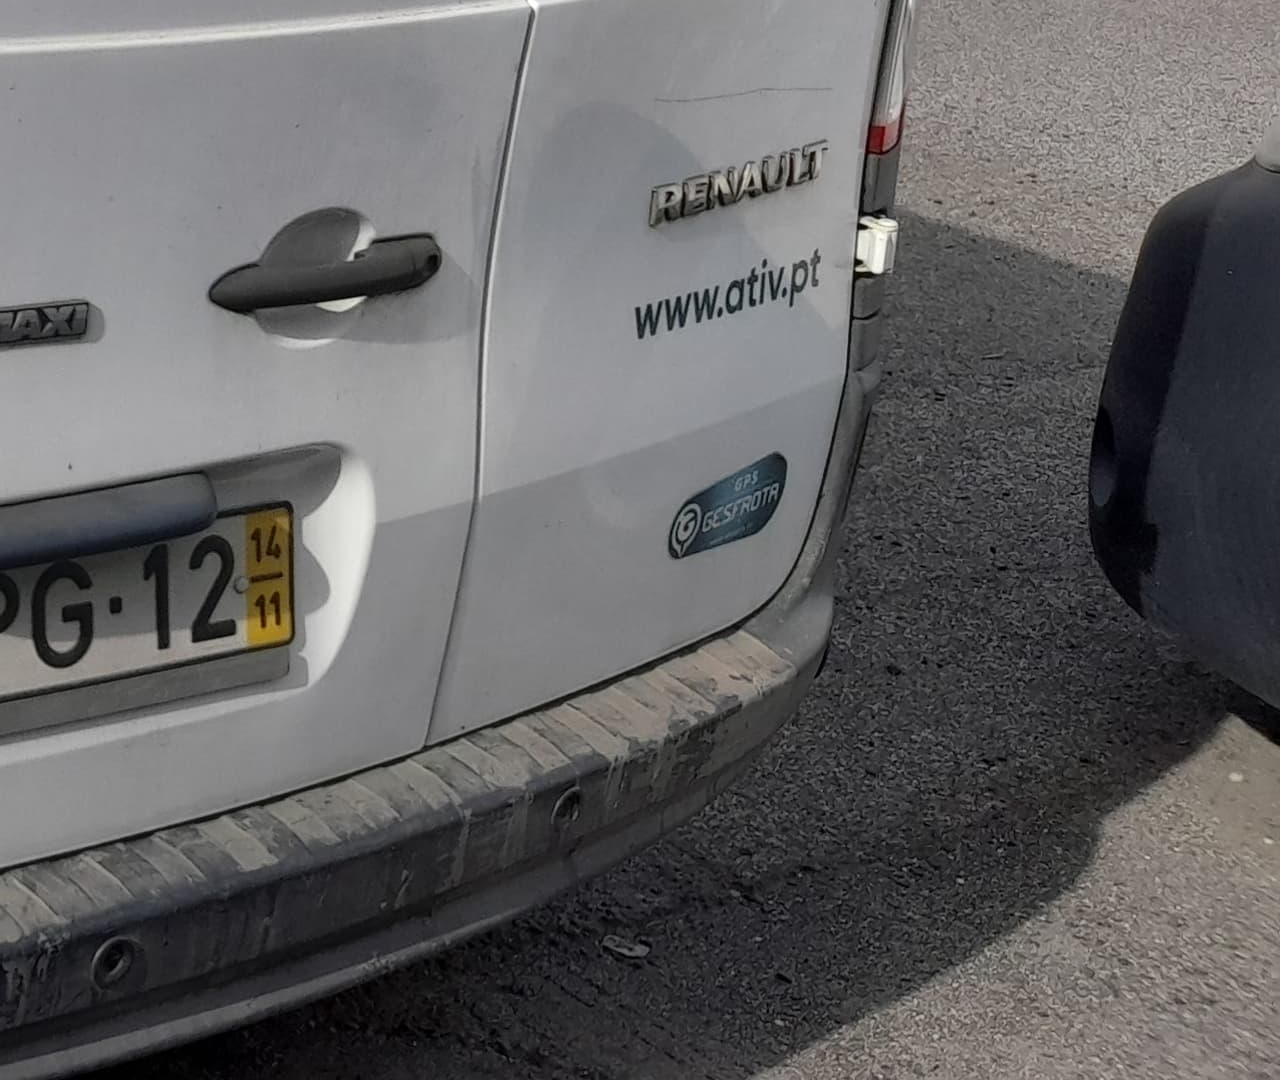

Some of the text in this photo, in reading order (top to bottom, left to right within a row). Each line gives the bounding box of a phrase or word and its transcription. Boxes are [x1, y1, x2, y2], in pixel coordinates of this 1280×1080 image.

[648, 140, 829, 226] RENAULT
[634, 248, 822, 340] www.ativ.pt
[734, 470, 760, 493] GPS
[702, 482, 780, 533] GESFROTA
[250, 523, 282, 564] 14
[254, 590, 282, 630] 11
